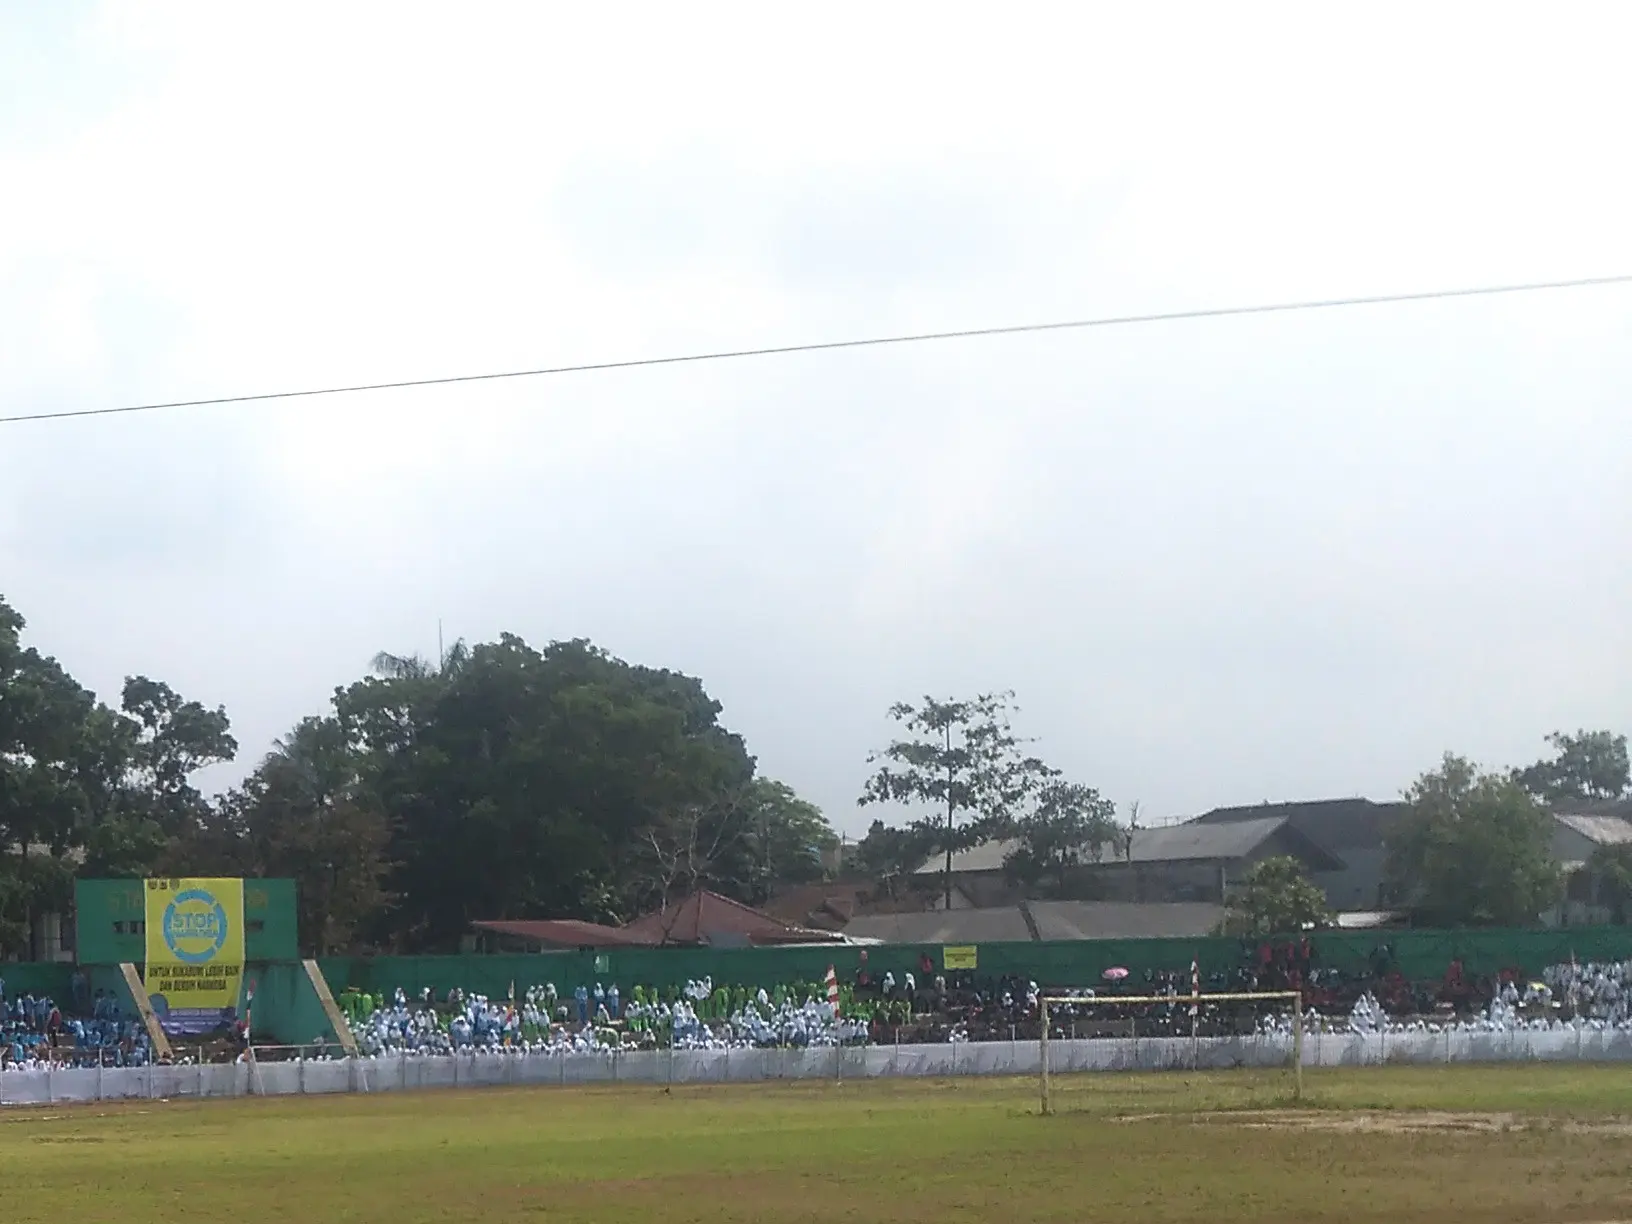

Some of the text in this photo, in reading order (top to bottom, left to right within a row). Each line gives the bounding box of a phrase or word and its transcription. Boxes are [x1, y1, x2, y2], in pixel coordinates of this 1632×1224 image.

[172, 912, 216, 928] STOP
[149, 966, 170, 978] UNTUK
[159, 980, 173, 992] DAN
